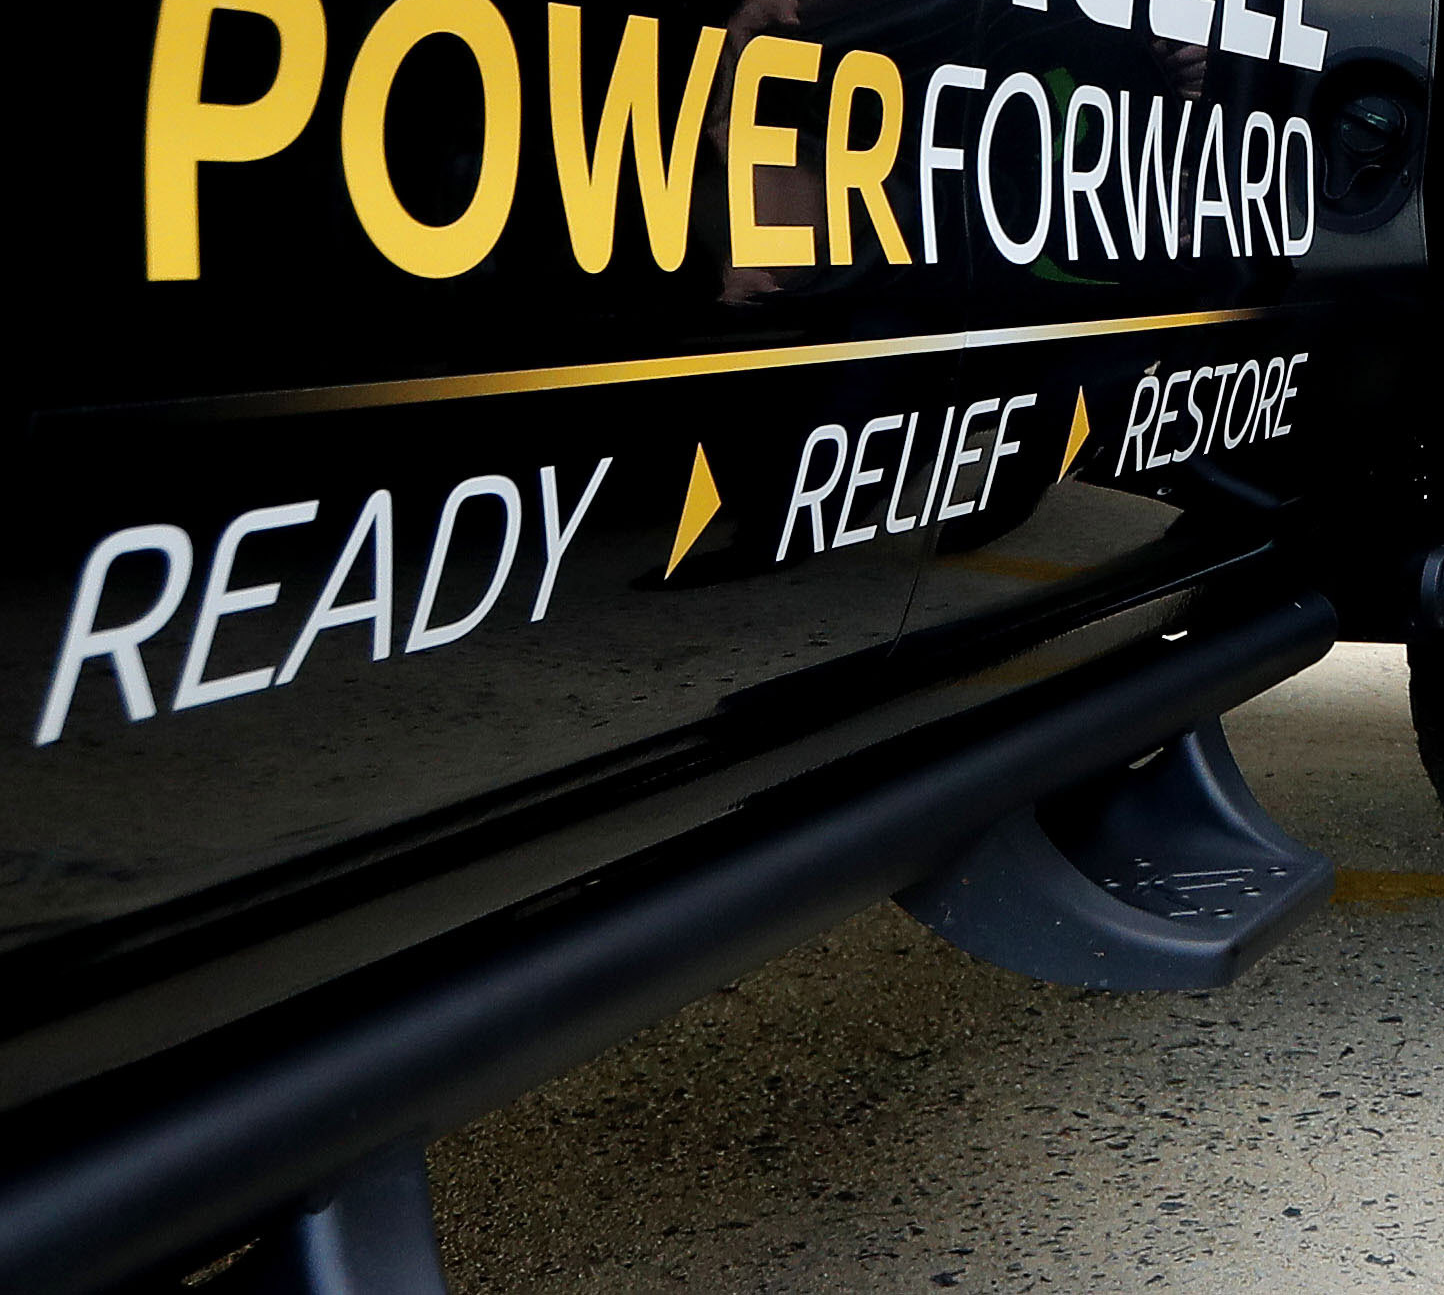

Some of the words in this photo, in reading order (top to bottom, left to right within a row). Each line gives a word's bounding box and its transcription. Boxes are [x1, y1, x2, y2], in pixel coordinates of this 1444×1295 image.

[36, 456, 613, 747] READY
[775, 393, 1038, 563] RELIEF
[1114, 352, 1310, 478] RESTORE
